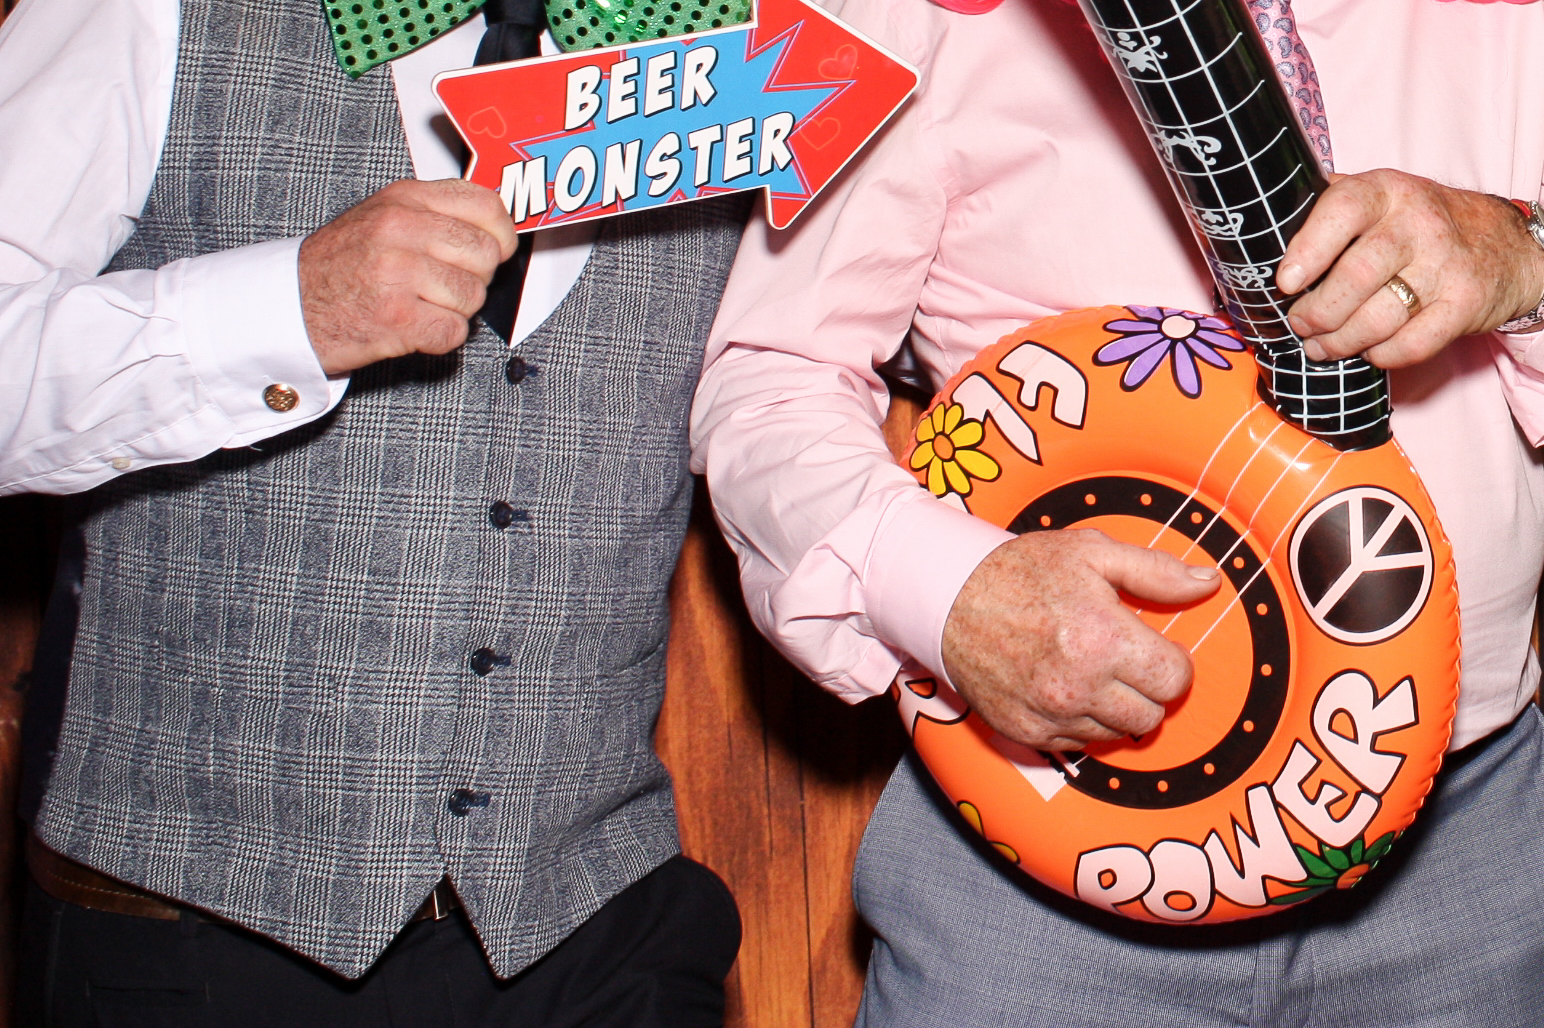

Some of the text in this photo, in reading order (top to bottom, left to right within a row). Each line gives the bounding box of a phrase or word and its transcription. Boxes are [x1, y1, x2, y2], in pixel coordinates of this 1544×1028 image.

[565, 46, 719, 131] BEER
[501, 112, 796, 224] MONSTER
[1076, 671, 1419, 923] POWER
